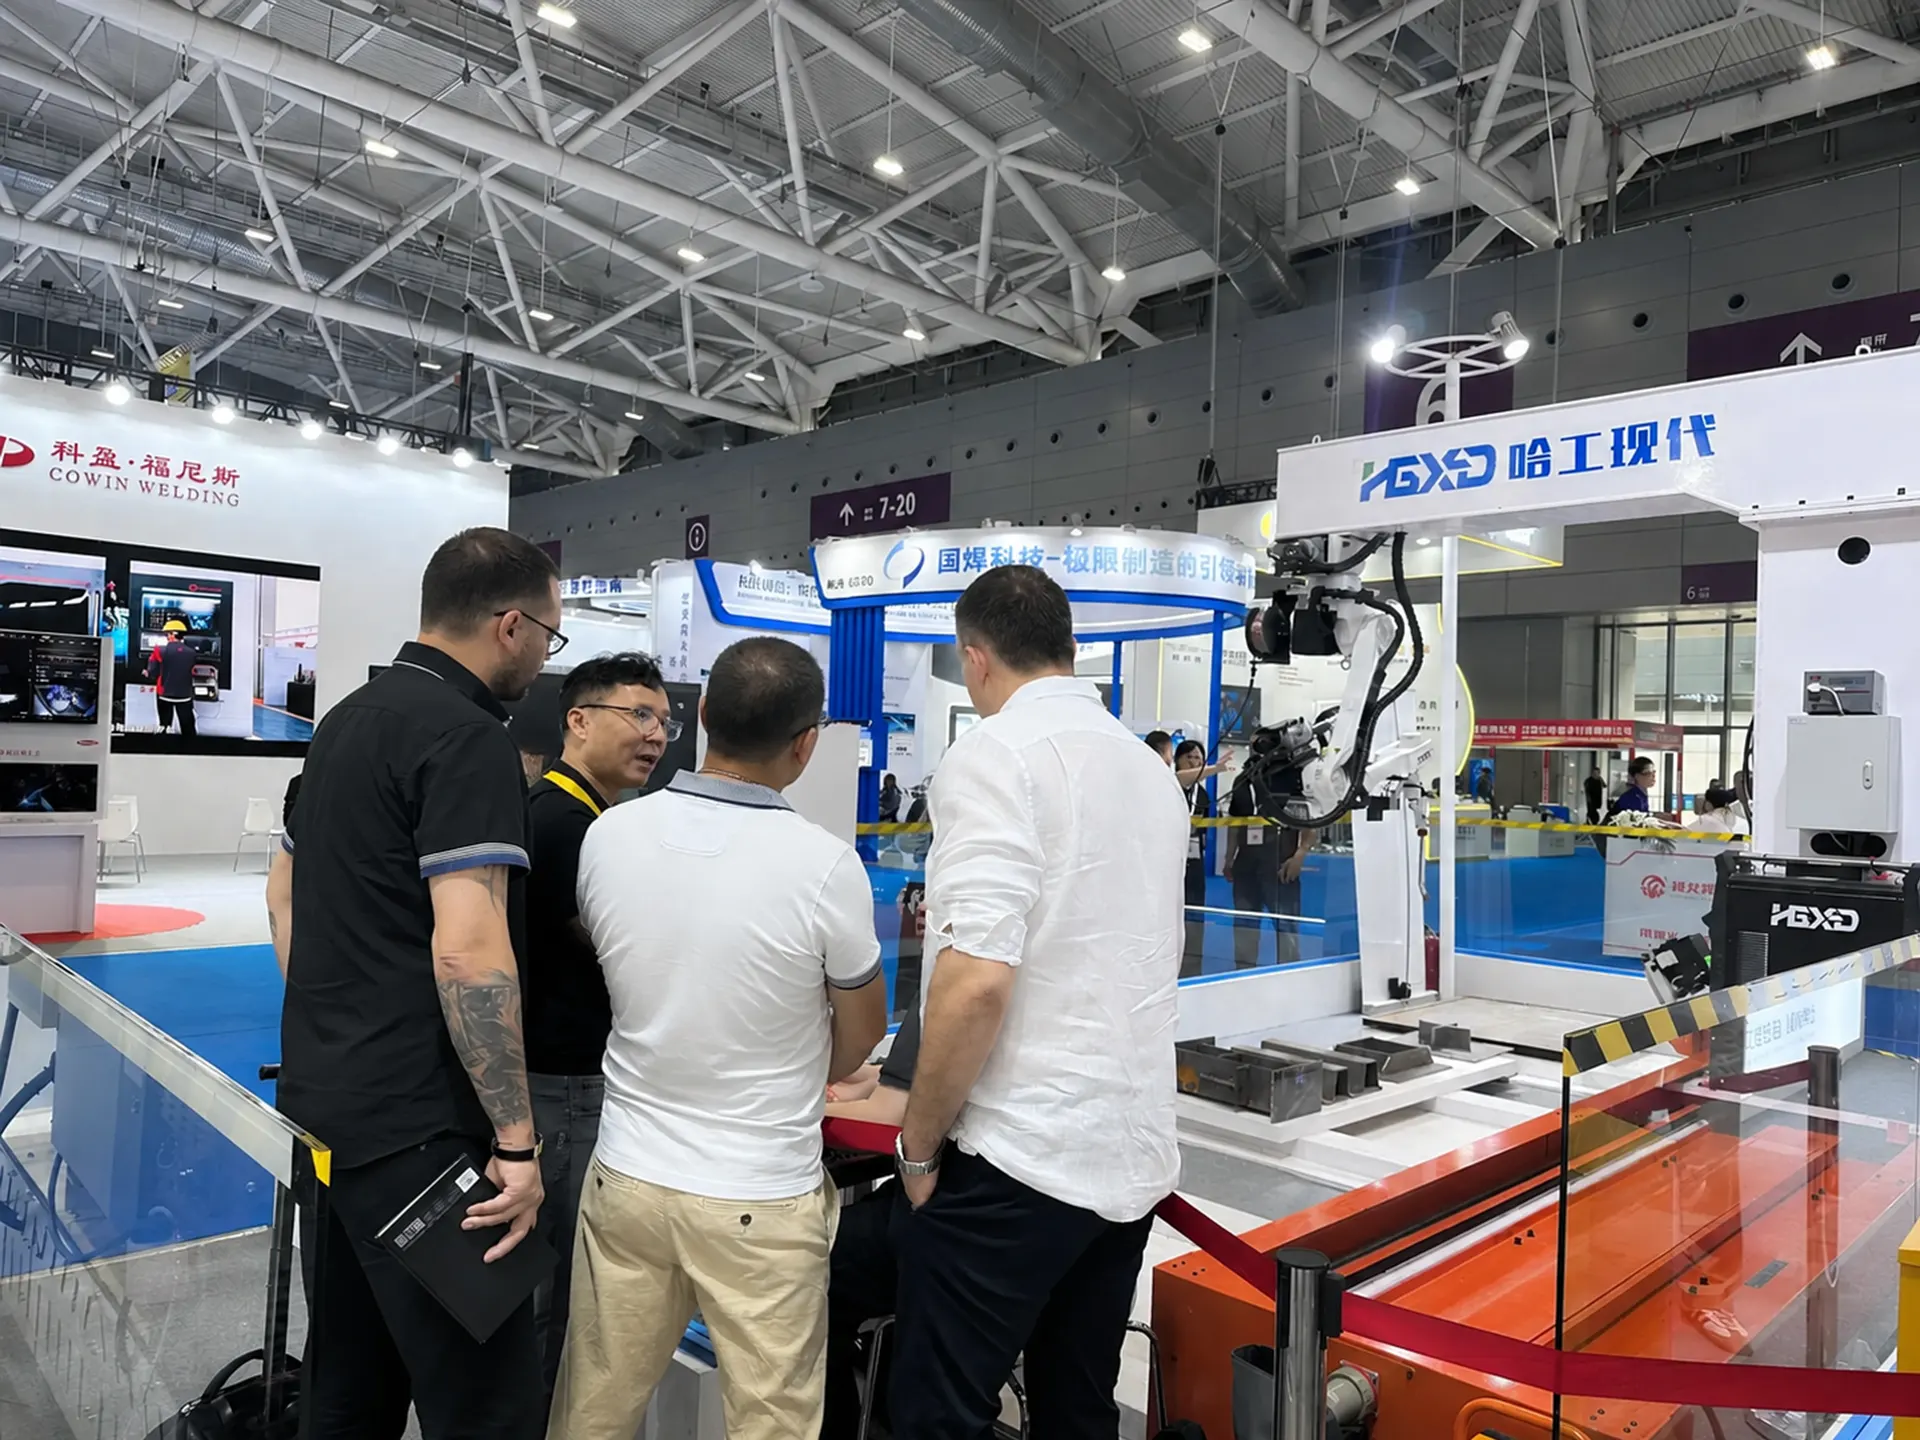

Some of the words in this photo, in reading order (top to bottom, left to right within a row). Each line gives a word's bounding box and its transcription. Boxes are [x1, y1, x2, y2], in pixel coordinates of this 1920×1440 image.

[1508, 413, 1716, 480] 哈工现代
[50, 440, 241, 489] 科盈·福尼斯
[49, 466, 129, 491] COWIN
[138, 480, 241, 508] WELDING
[879, 491, 916, 519] 7-20
[1686, 585, 1696, 600] 6
[1770, 903, 1860, 932] HGXD
